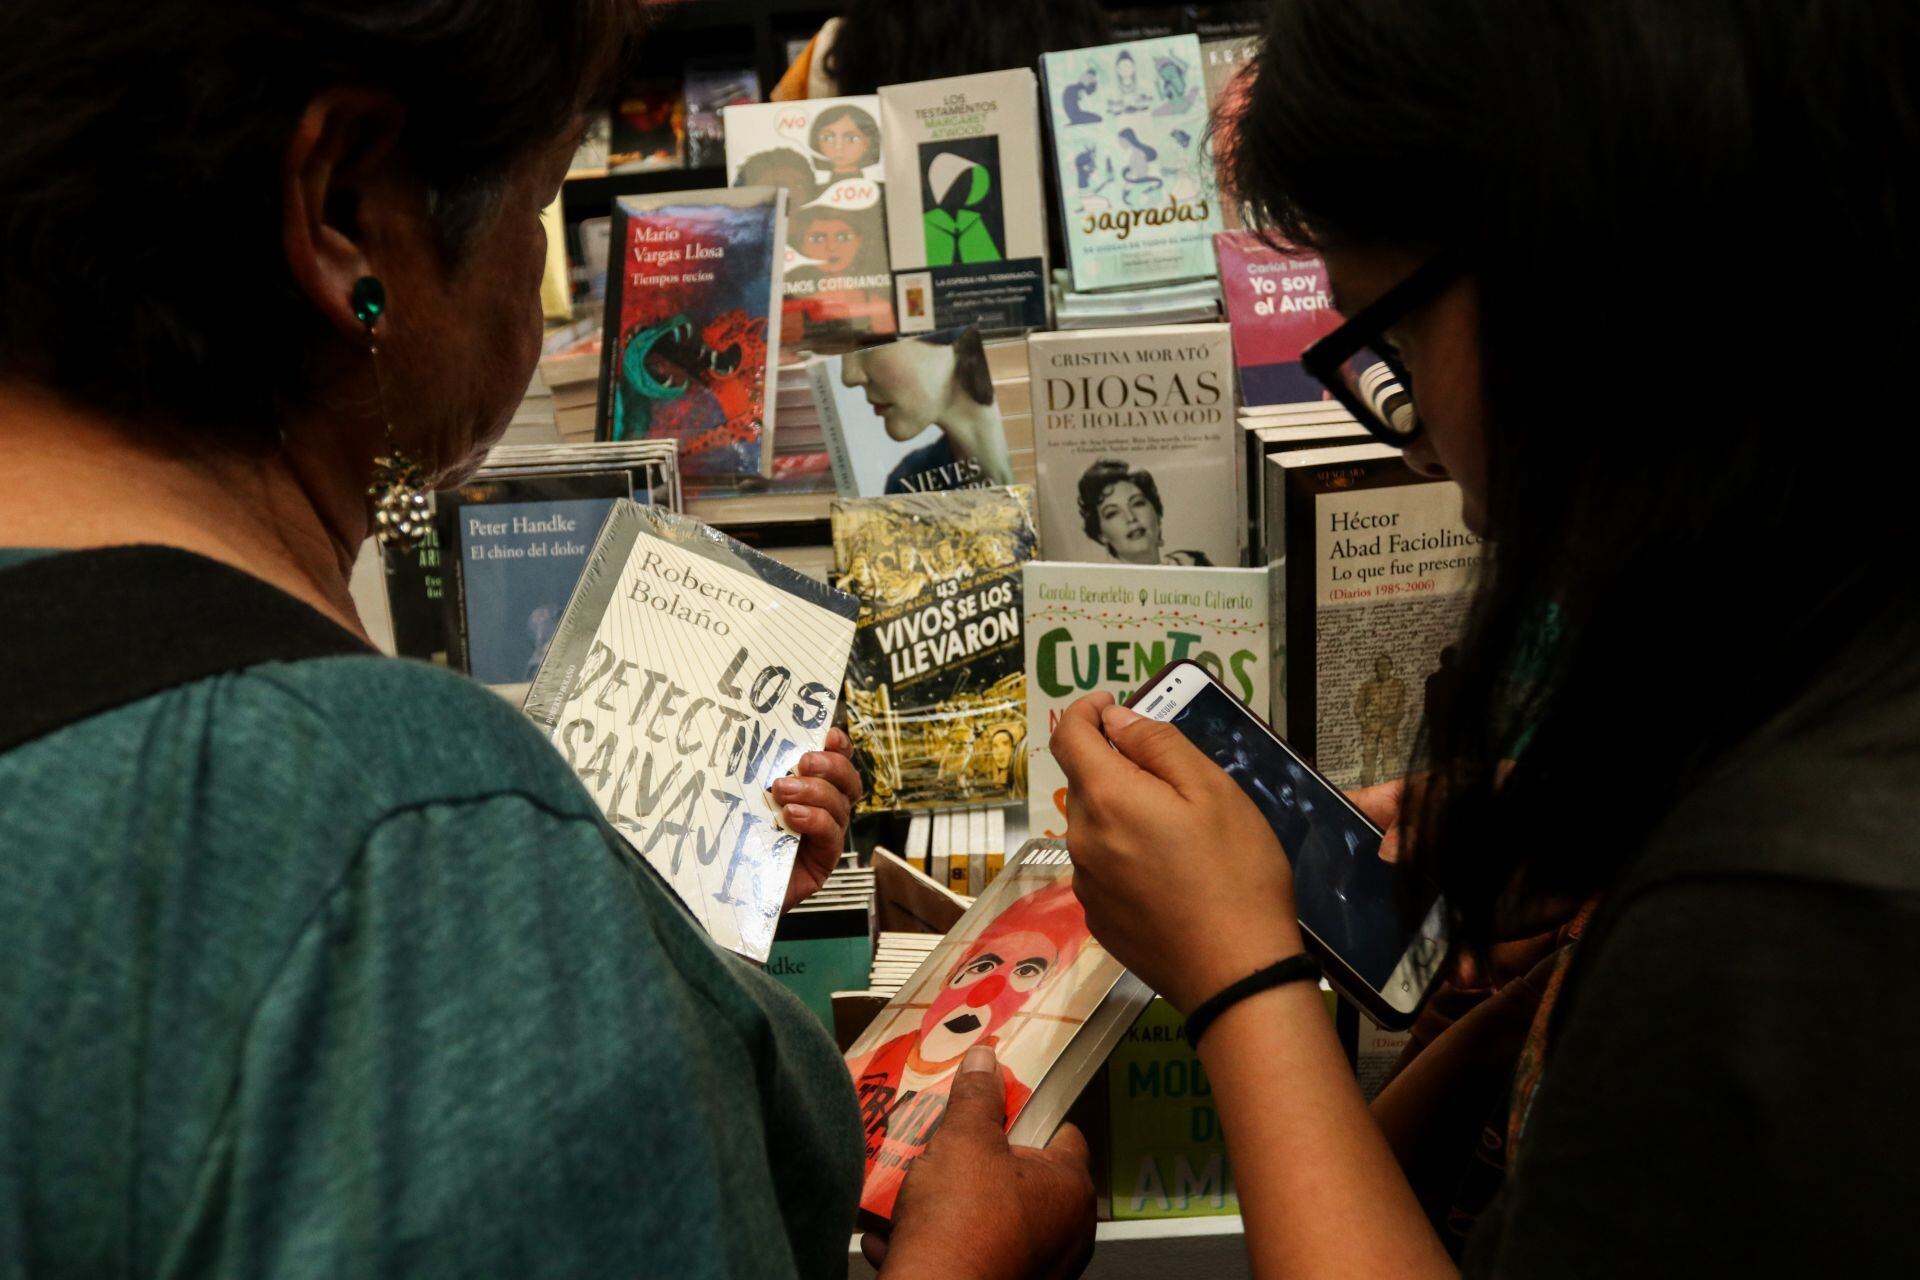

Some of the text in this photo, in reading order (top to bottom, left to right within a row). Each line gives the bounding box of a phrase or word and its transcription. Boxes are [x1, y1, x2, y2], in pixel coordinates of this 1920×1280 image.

[915, 101, 997, 119] TESTAMENTOS
[943, 93, 965, 105] LOS
[778, 116, 807, 129] NO
[831, 185, 873, 202] SON
[1083, 193, 1209, 240] sagradas
[634, 226, 680, 243] Mario
[634, 243, 725, 267] Vargas Llosa
[632, 270, 715, 288] Tiempos recios
[817, 274, 892, 291] COTIDIANOS
[1249, 275, 1317, 295] Yo soy
[1254, 290, 1331, 316] el Arañ
[1051, 344, 1210, 367] CRISTINA MORATÓ
[1044, 370, 1222, 412] DIOSAS
[1047, 408, 1222, 430] DE HOLLYWOOD
[899, 456, 981, 493] NIEVES
[469, 514, 576, 536] Peter Handke
[1330, 510, 1400, 532] Héctor
[471, 541, 585, 560] El chino del dolor
[1329, 535, 1381, 559] Abad
[640, 549, 755, 614] Roberto
[1332, 566, 1352, 582] Lo
[1357, 565, 1386, 583] que
[1390, 559, 1414, 575] fue
[936, 579, 959, 599] 43
[1329, 578, 1436, 602] (Diarios 1985-2006)
[625, 577, 731, 639] Bolaño
[875, 599, 956, 654] VIVOS
[957, 594, 978, 620] SE
[980, 581, 1013, 612] LOS
[890, 606, 1020, 683] LLEVARON
[1036, 627, 1258, 705] CUENTOS
[717, 646, 836, 730] LOS
[567, 640, 797, 795] DETECTIV
[760, 956, 806, 975] ndke
[1192, 1105, 1223, 1142] D
[1130, 1152, 1230, 1212] AM
